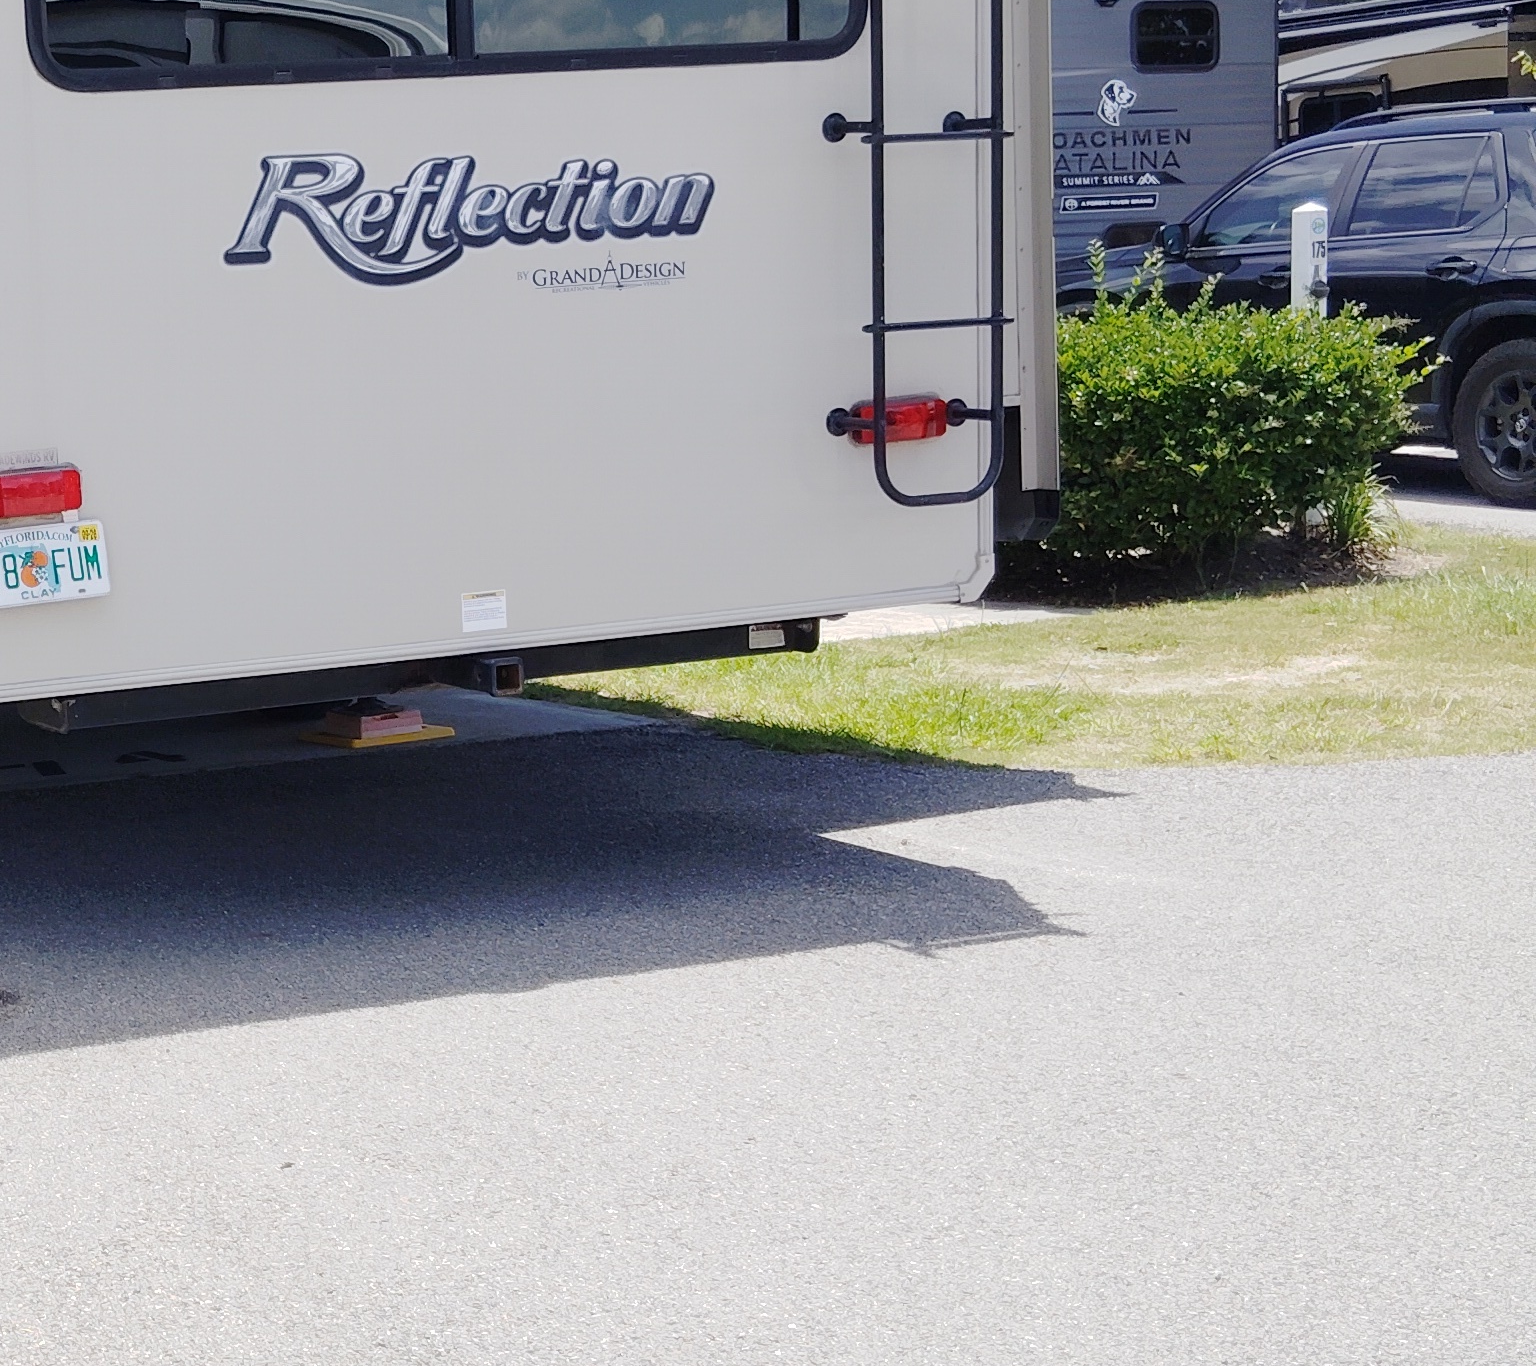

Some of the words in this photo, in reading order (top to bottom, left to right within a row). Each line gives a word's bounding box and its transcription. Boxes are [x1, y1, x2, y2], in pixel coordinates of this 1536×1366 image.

[1052, 128, 1191, 149] OACHMEN
[1054, 149, 1181, 172] ATALINA
[1062, 176, 1099, 186] SUMMIT
[1102, 175, 1135, 185] SERIES
[223, 152, 716, 286] Reflection
[1312, 240, 1325, 258] 175
[517, 271, 529, 281] BY
[532, 267, 602, 287] GRAND
[619, 261, 686, 281] DESIGN
[551, 285, 595, 293] RECREATIONAL
[44, 449, 55, 462] RV
[51, 545, 102, 584] FUM
[21, 588, 57, 600] CLAY
